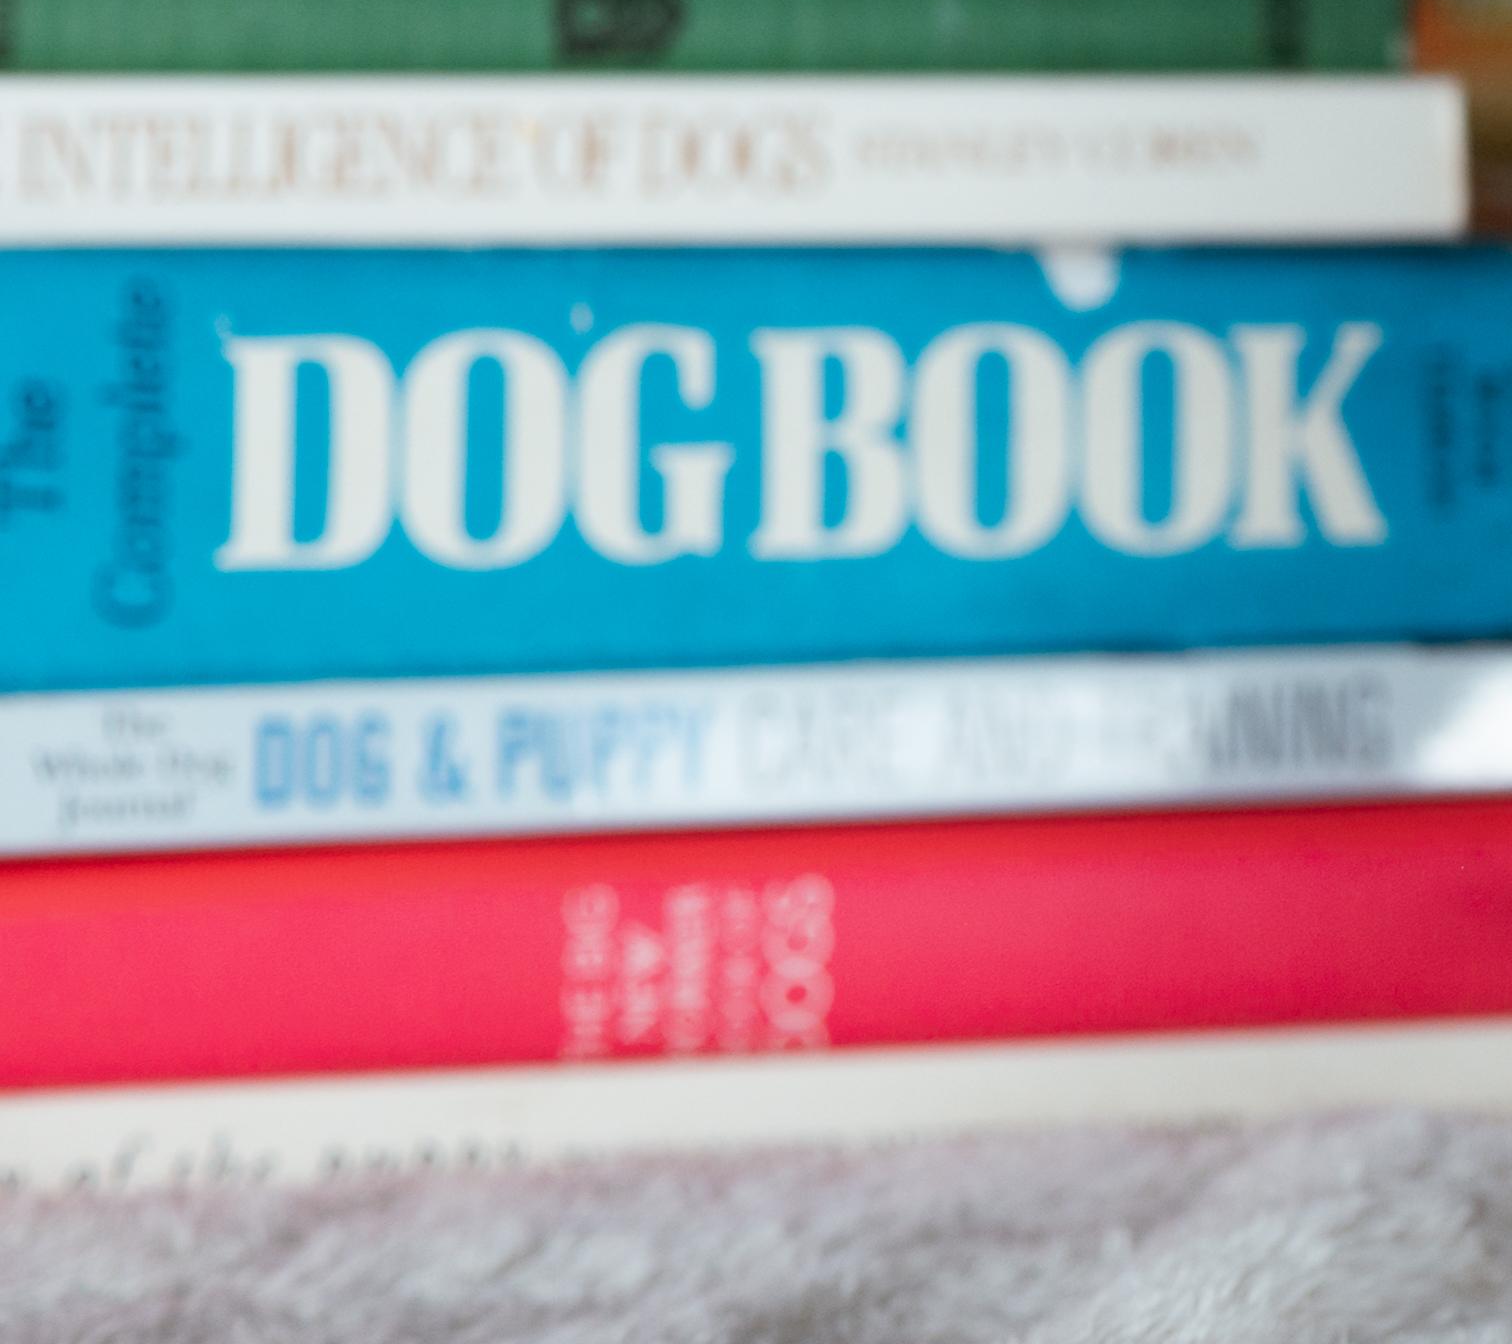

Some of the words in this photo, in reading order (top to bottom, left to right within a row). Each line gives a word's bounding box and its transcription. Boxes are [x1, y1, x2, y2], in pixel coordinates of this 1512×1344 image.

[18, 110, 516, 198] INTELLIGENCE
[532, 110, 622, 196] OF
[638, 108, 832, 196] DOGS
[0, 378, 64, 522] The
[94, 278, 186, 628] Complete
[214, 322, 738, 574] DOG
[746, 318, 1389, 560] BOOK
[256, 712, 390, 806] DOG
[418, 708, 468, 802] &
[498, 696, 712, 802] PUPPY
